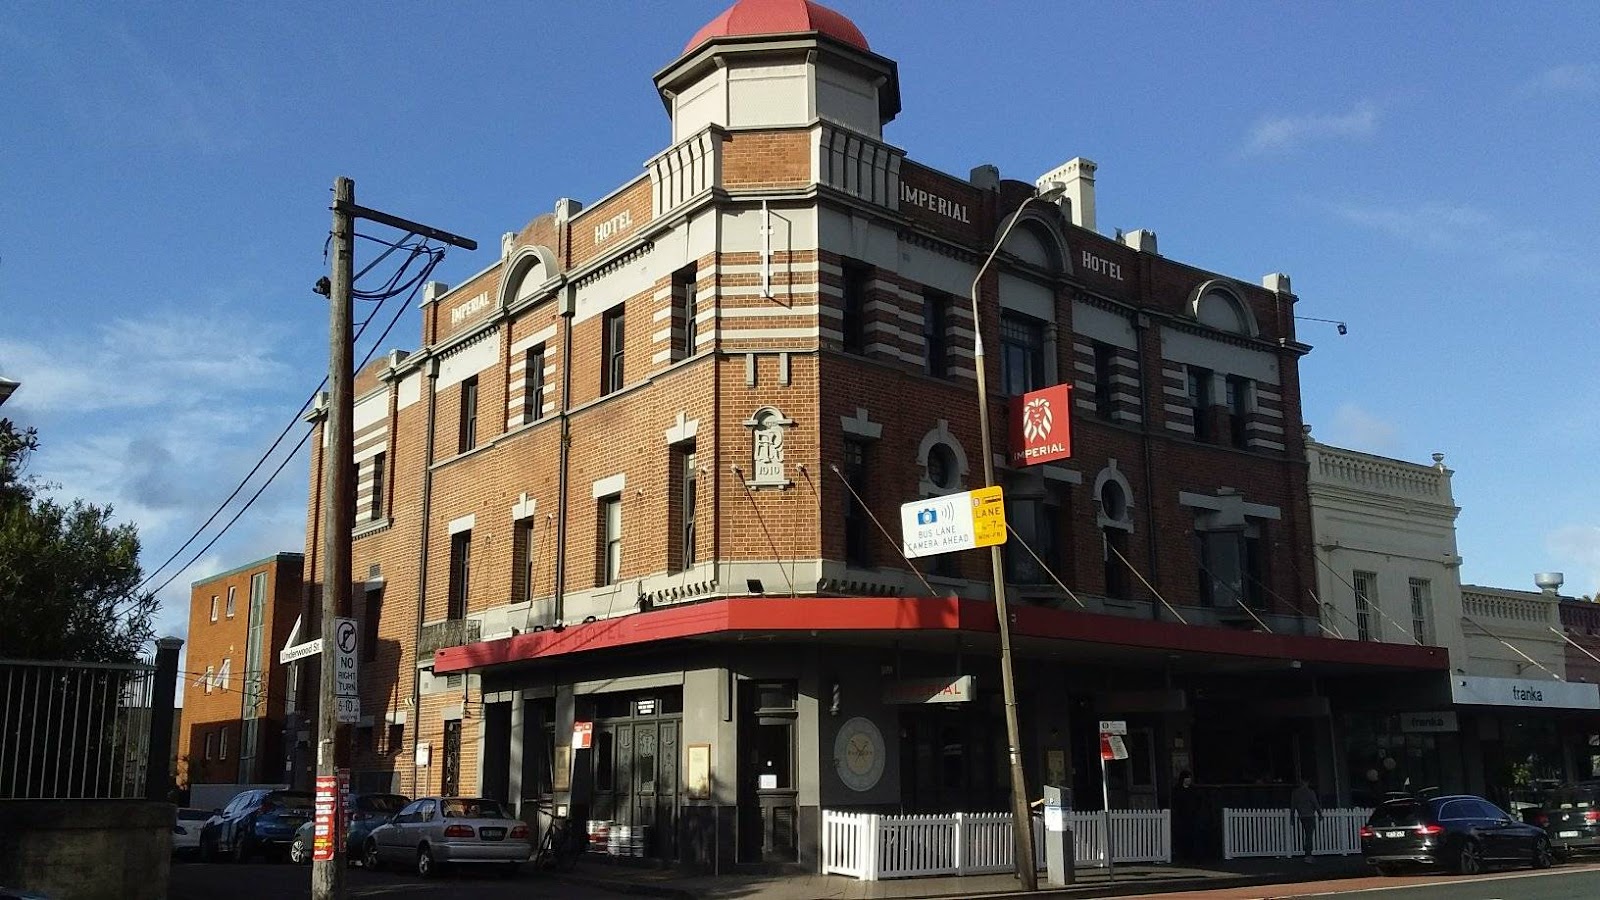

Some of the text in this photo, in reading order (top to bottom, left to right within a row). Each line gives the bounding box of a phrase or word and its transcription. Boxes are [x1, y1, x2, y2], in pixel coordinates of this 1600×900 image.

[900, 181, 971, 224] IMPERIAL
[594, 209, 633, 246] HOTEL
[1082, 250, 1124, 281] HOTEL
[451, 291, 490, 325] IMPERIAL
[1013, 443, 1066, 460] IMPERIAL
[975, 507, 1001, 519] LANE
[918, 525, 956, 539] BUS LANE
[908, 534, 970, 551] CAMERA AHEAD
[281, 645, 313, 661] Underwood
[340, 656, 354, 669] NO
[338, 671, 355, 680] RIGHT
[338, 682, 356, 691] TURN
[1512, 685, 1543, 702] franka
